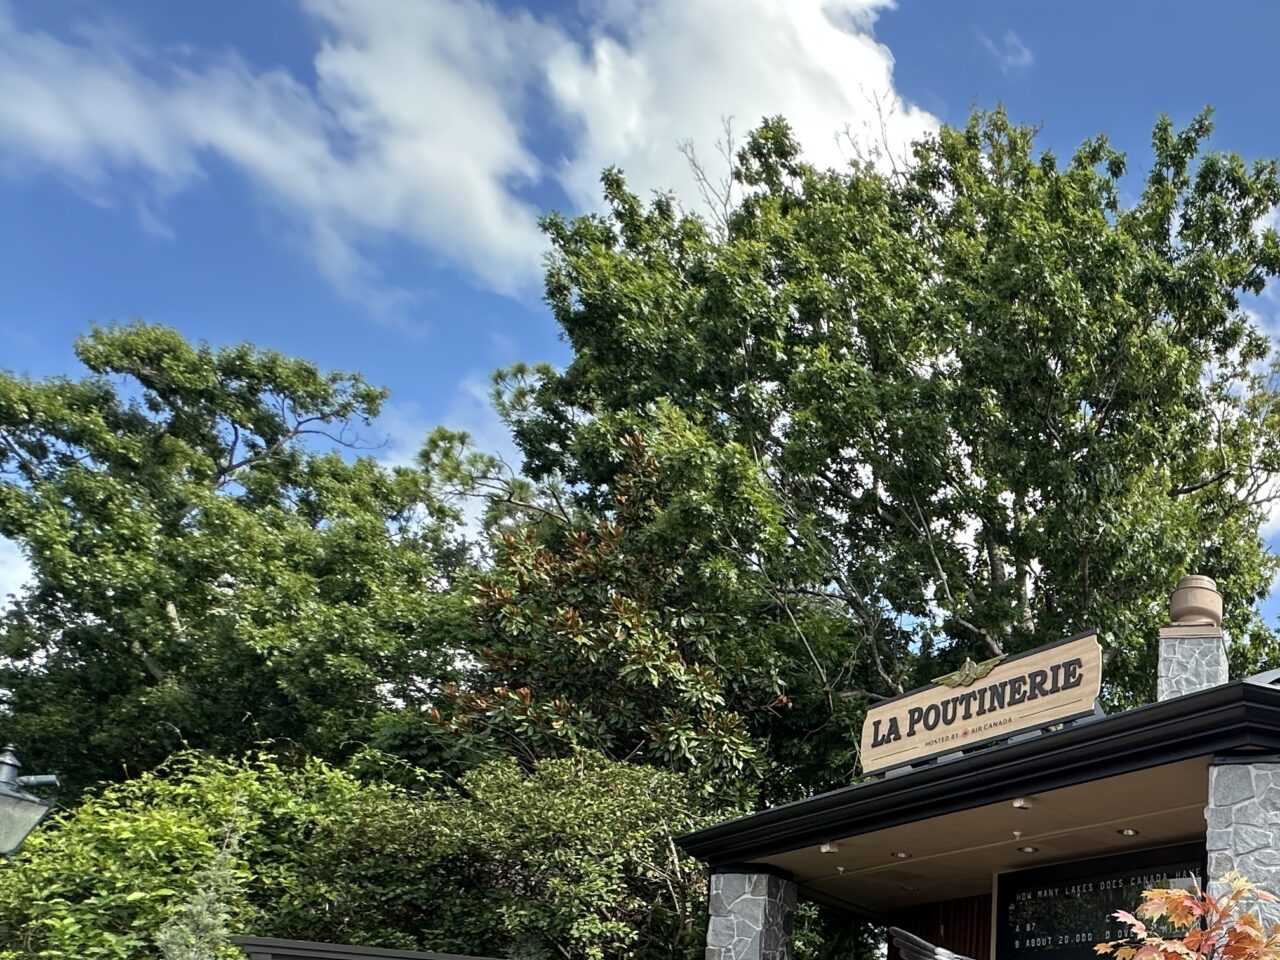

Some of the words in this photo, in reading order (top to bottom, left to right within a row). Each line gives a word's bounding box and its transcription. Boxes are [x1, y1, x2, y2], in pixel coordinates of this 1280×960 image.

[871, 717, 901, 748] LA
[907, 658, 1083, 737] POUTINERIE
[925, 735, 950, 747] HOSTED
[971, 726, 983, 734] AIR
[984, 717, 1013, 731] CANADA
[1016, 892, 1032, 901] HOW
[1037, 887, 1059, 899] MANY
[1065, 882, 1093, 895] LAKES
[1100, 879, 1124, 890] DOES
[1130, 872, 1168, 885] CANADA
[1025, 936, 1052, 948] ABOUT
[1117, 929, 1134, 938] OVE
